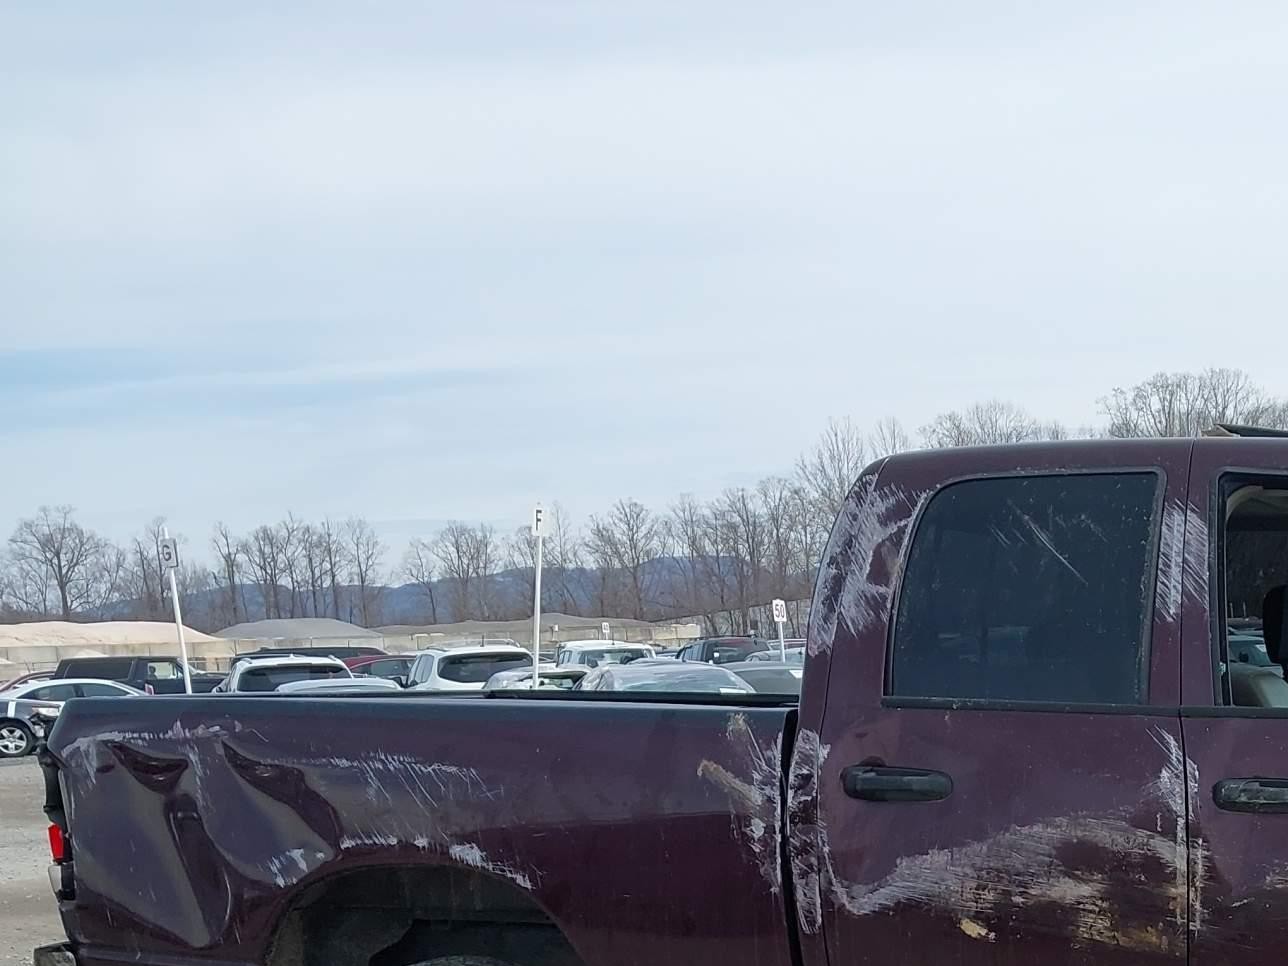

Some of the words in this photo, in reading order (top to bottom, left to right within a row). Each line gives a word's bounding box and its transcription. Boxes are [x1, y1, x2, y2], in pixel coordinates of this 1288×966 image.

[535, 509, 543, 531] F
[162, 544, 172, 562] G
[774, 603, 785, 619] 50
